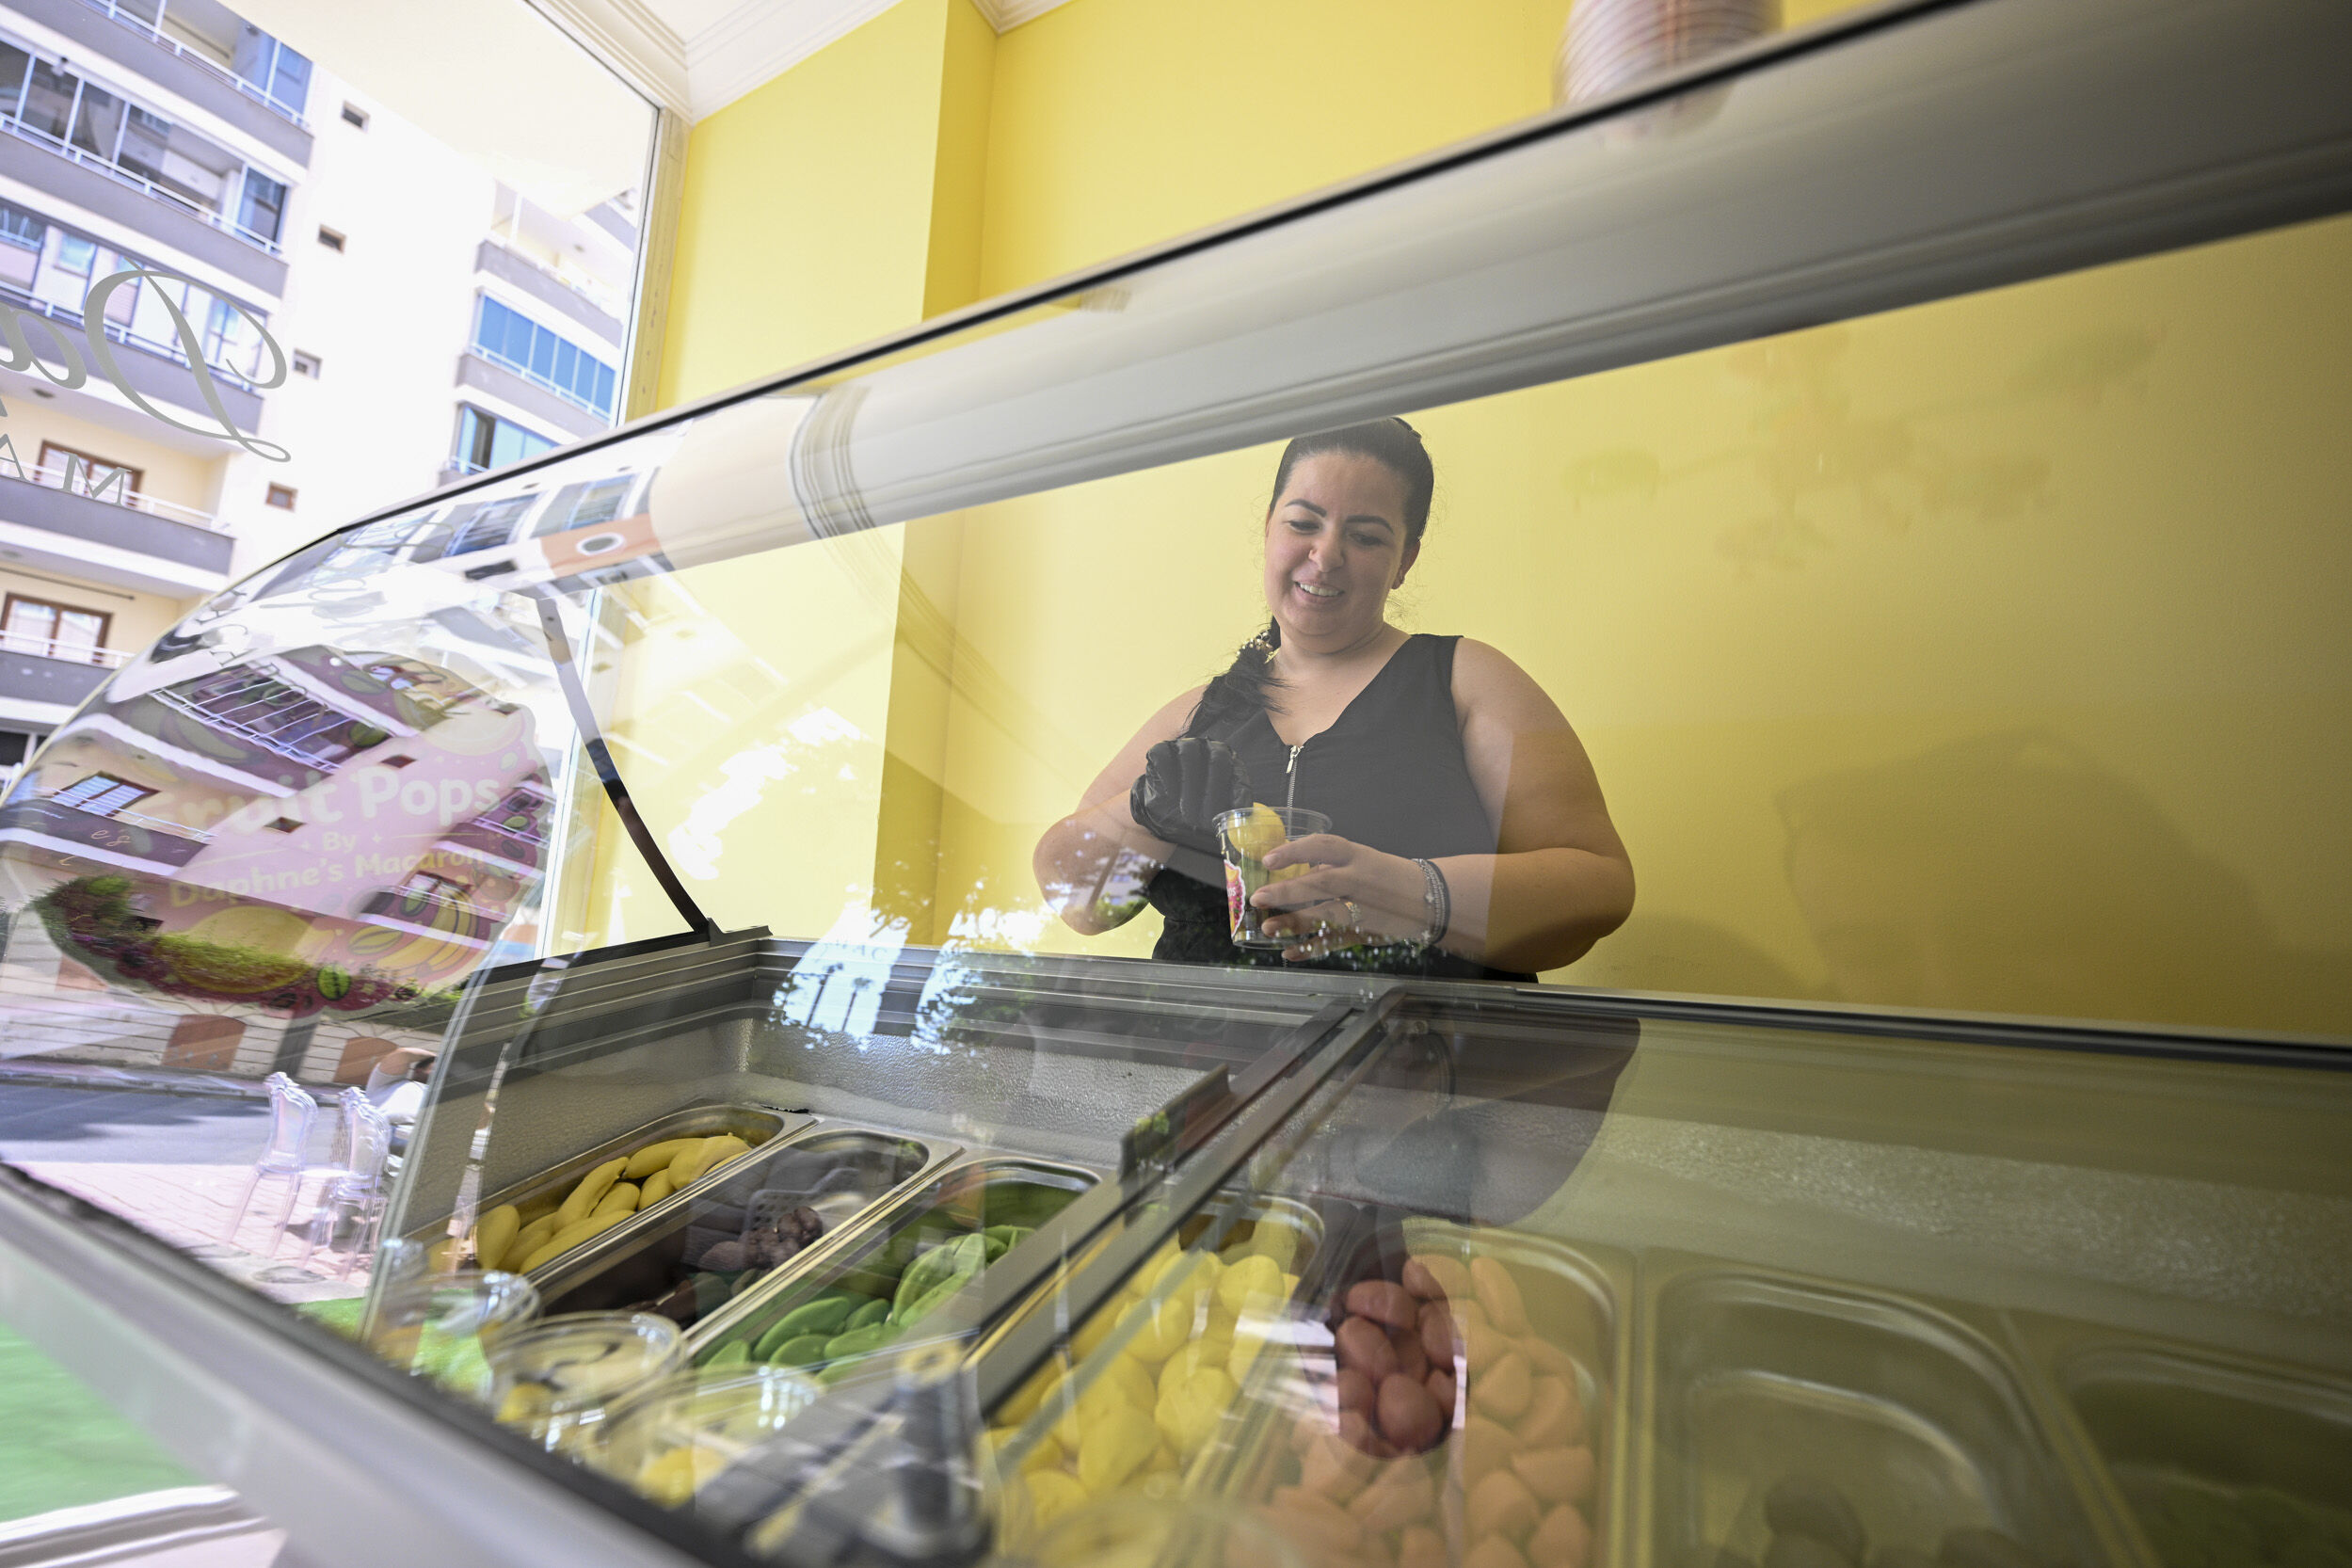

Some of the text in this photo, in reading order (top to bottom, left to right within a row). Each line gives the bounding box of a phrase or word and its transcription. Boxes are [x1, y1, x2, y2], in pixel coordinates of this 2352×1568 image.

[355, 766, 501, 826] Pops
[323, 830, 357, 854] By
[169, 847, 484, 907] Daphne's Macaron
